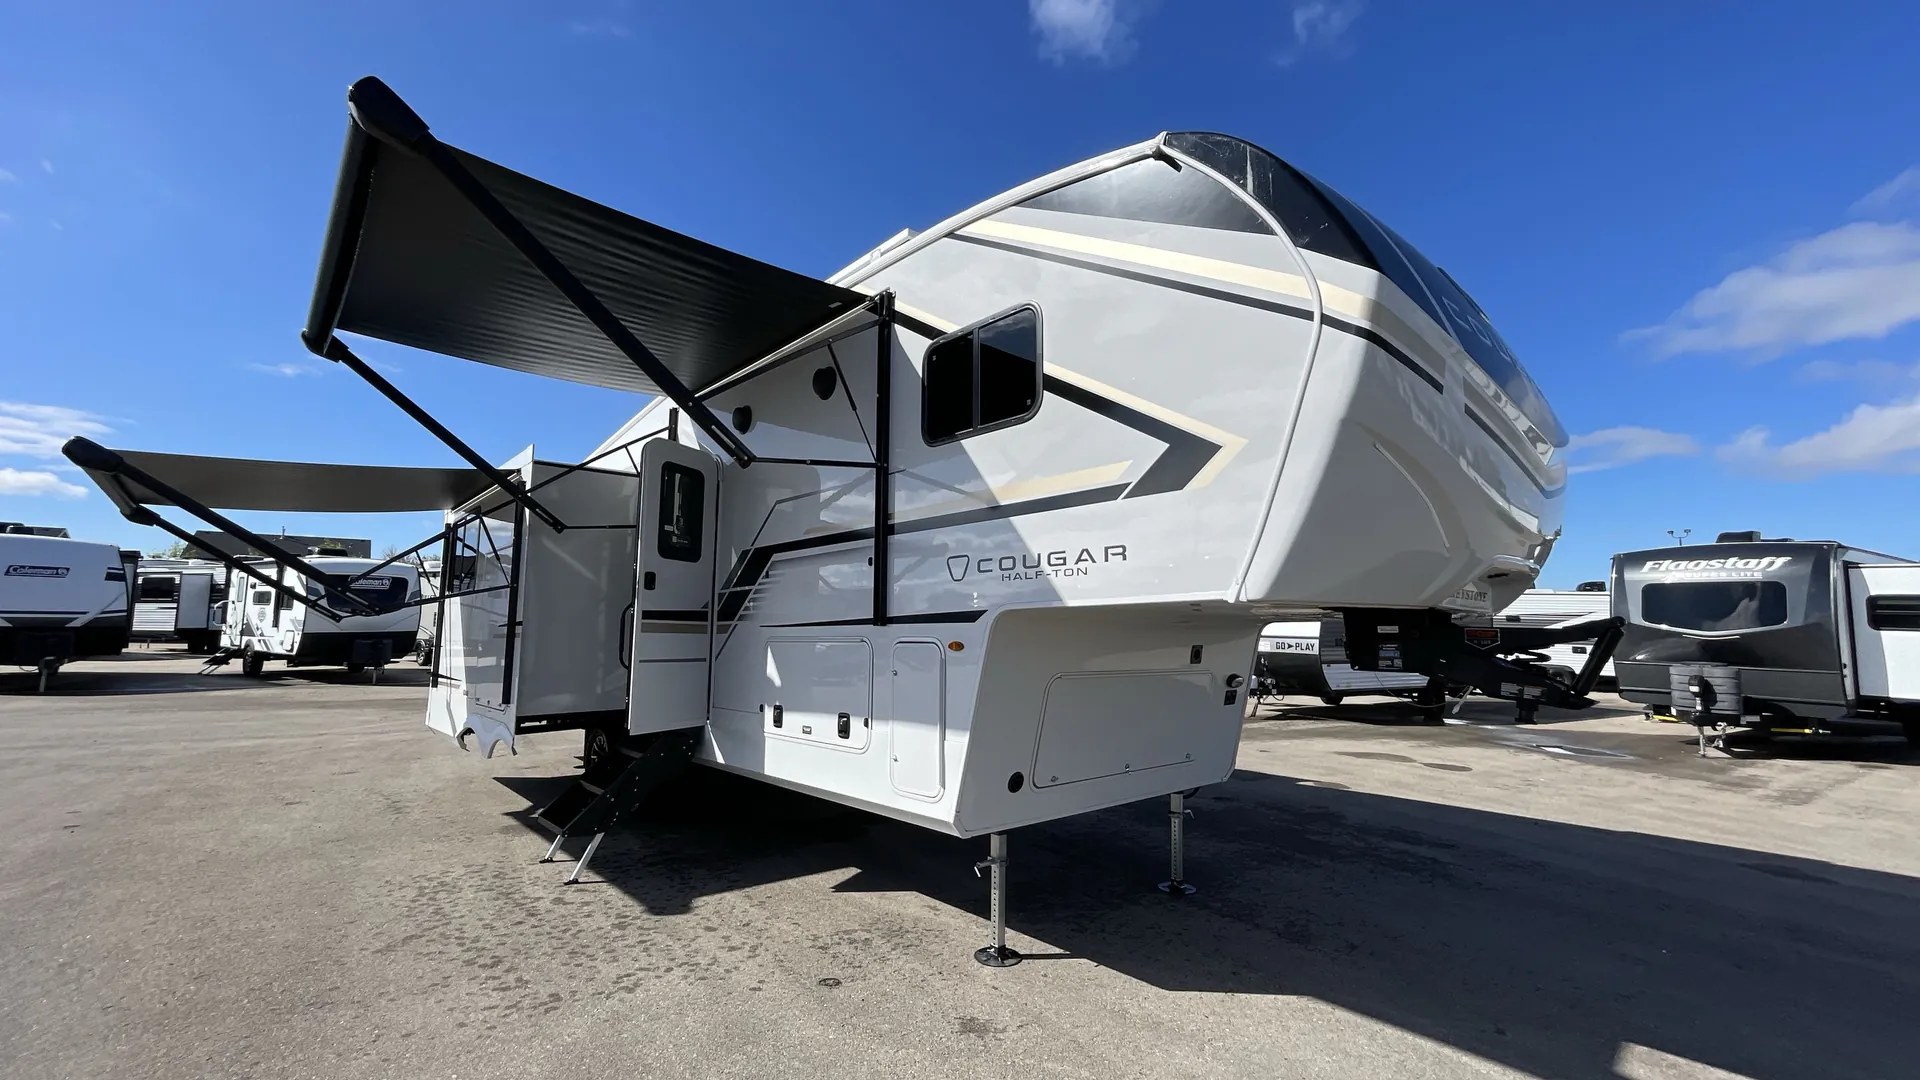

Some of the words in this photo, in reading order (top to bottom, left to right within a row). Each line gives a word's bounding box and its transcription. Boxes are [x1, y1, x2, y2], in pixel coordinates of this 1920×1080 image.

[977, 545, 1127, 573] COUGAR
[1640, 556, 1793, 573] Flagstaff
[9, 565, 57, 575] Coleman
[1001, 567, 1089, 582] HALF-TON
[353, 577, 382, 586] oleman
[1295, 642, 1315, 651] PLAY
